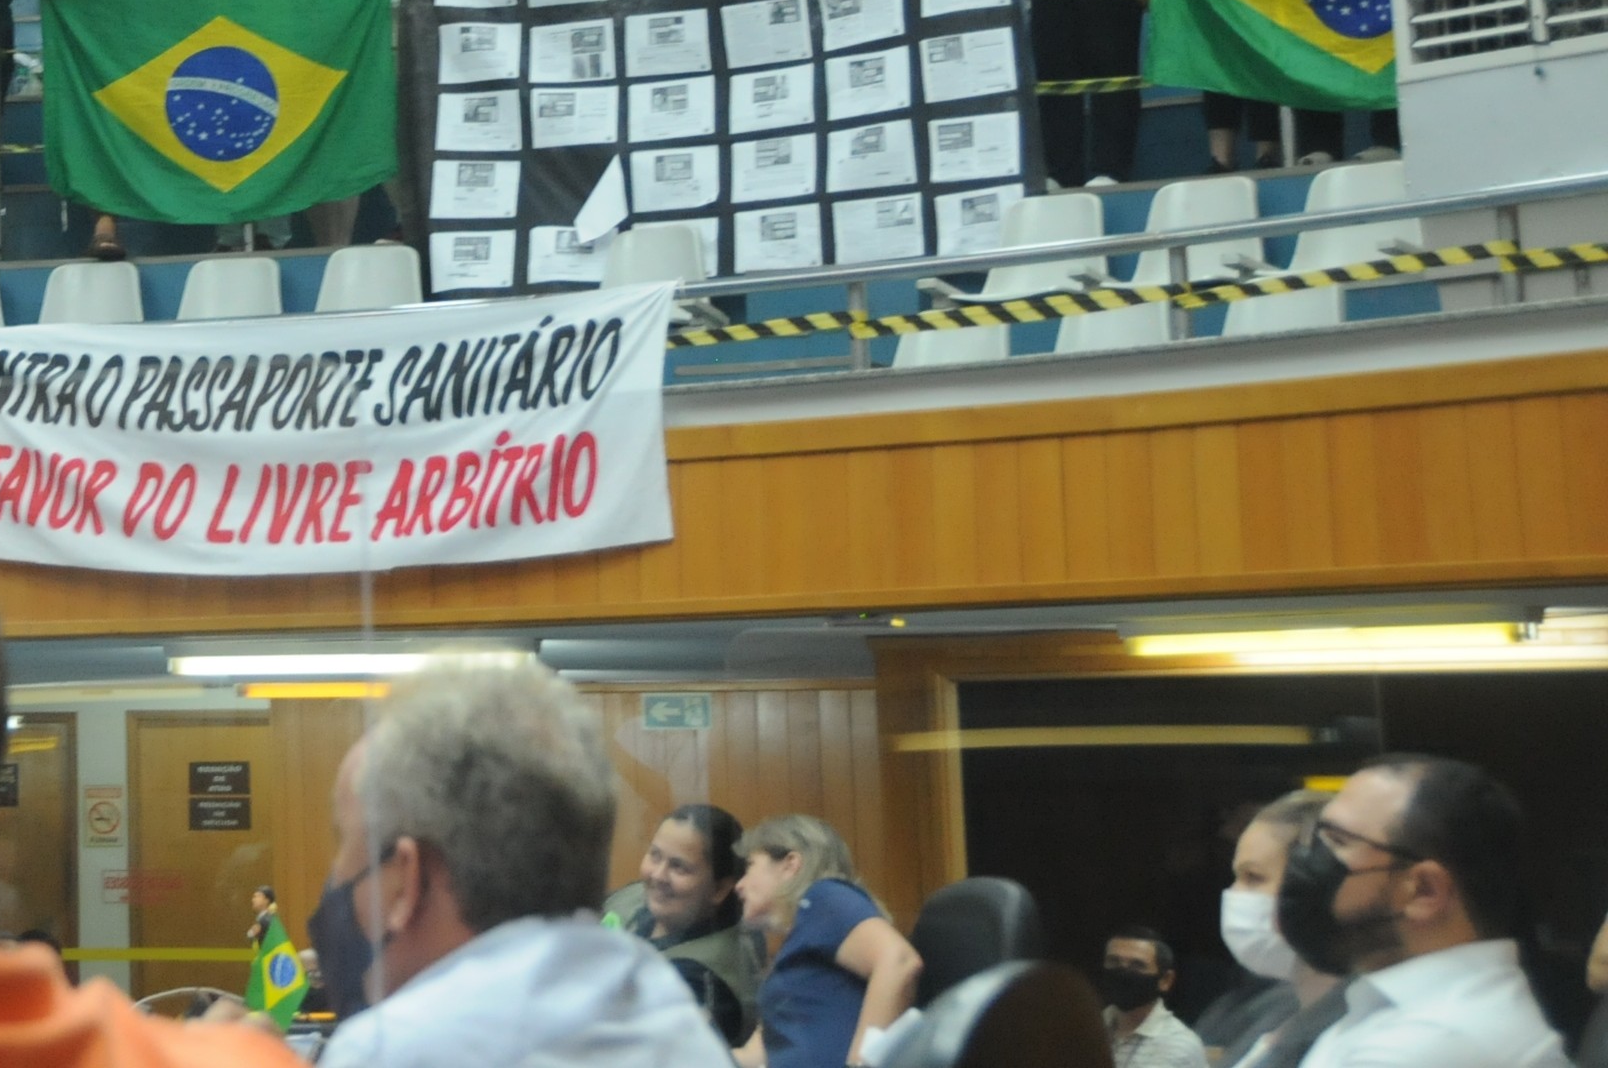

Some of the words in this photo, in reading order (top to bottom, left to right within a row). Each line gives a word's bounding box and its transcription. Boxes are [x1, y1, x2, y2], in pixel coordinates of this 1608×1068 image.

[85, 355, 125, 429] O
[118, 348, 384, 432] PASSAPORTE
[373, 314, 624, 427] SANITÁRIO
[122, 461, 198, 542] DO
[206, 459, 373, 545] LIVRE
[370, 430, 599, 542] ARBÍTRIO
